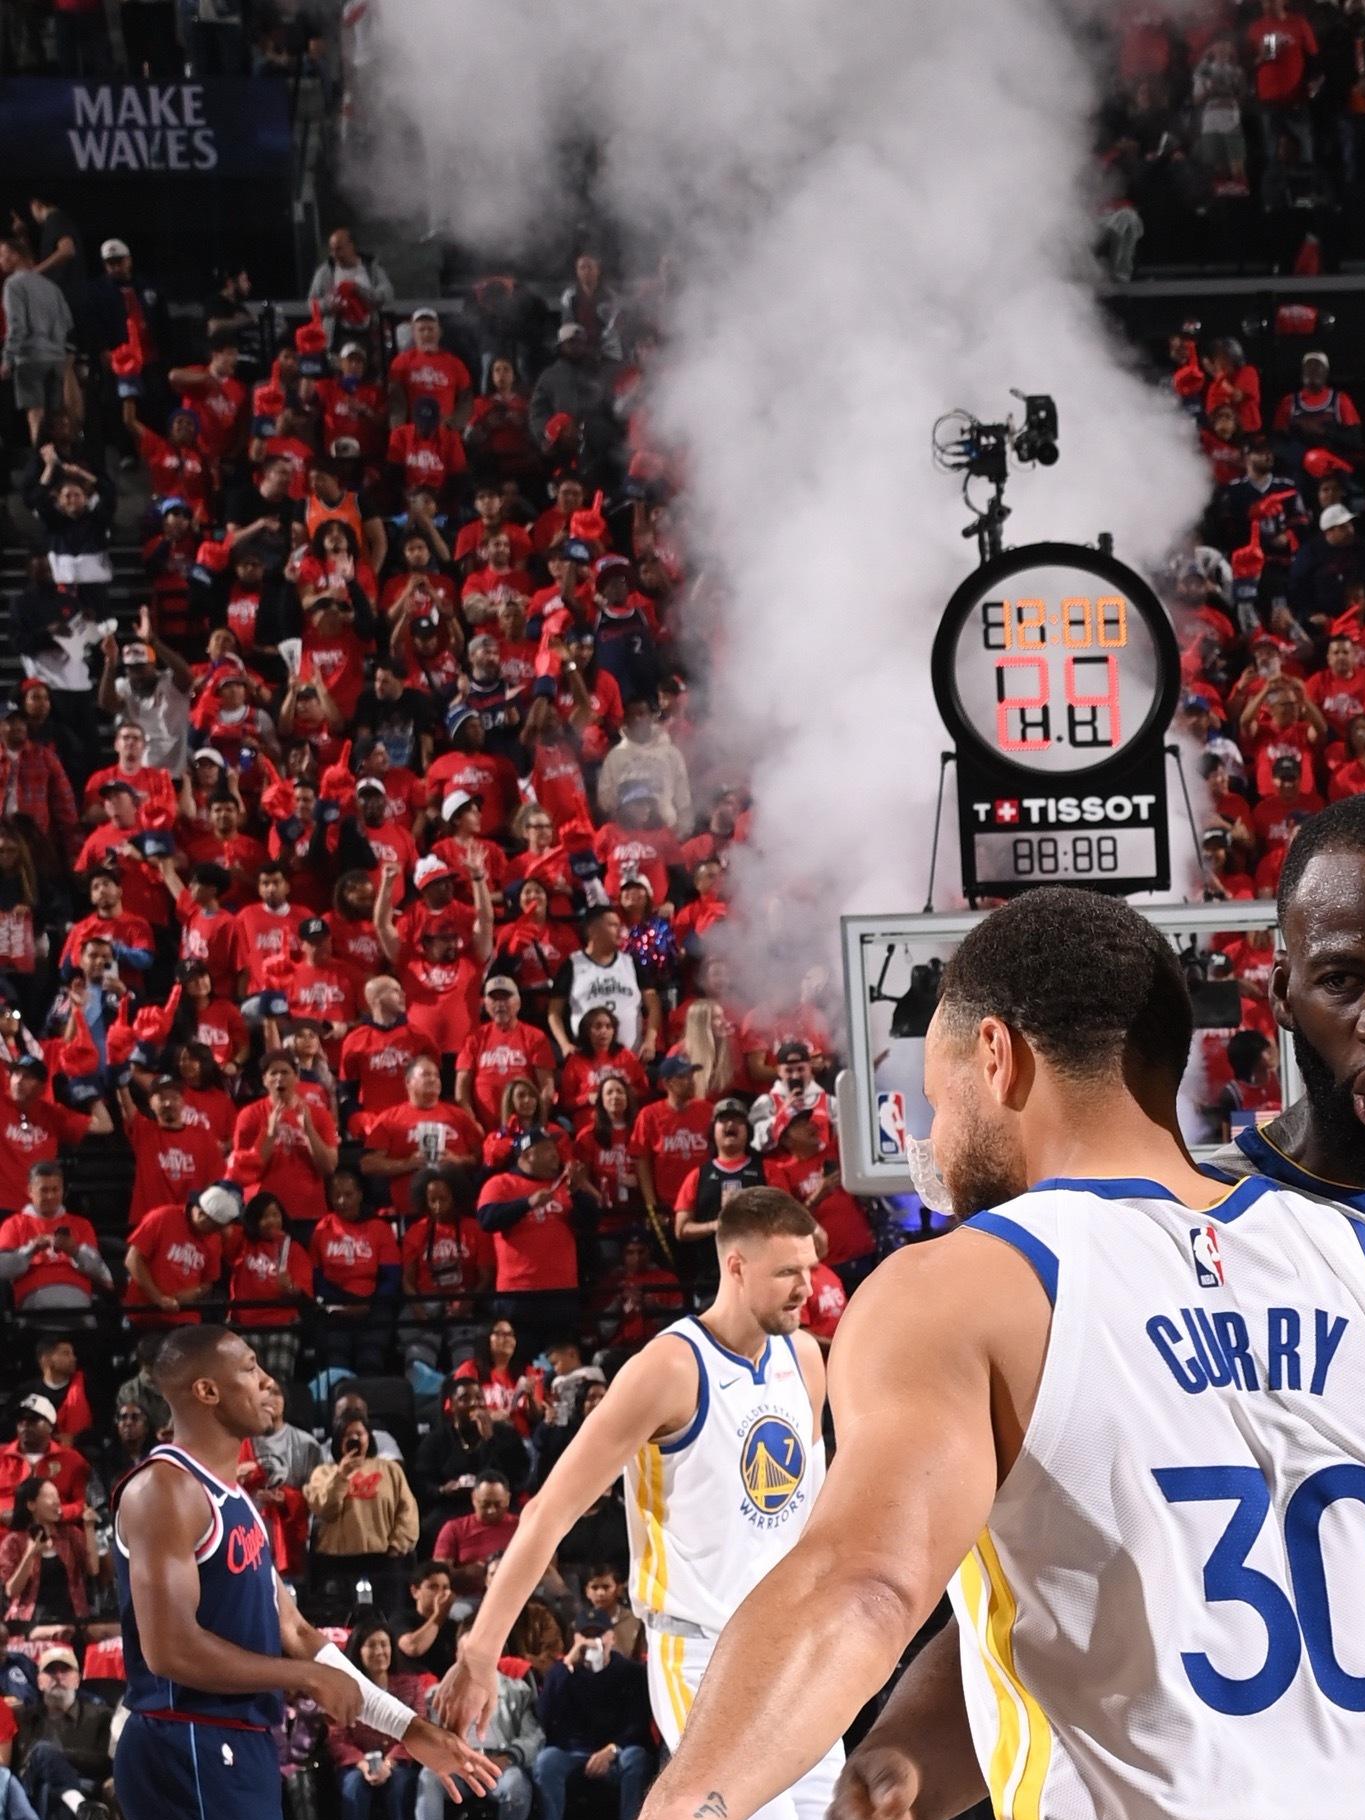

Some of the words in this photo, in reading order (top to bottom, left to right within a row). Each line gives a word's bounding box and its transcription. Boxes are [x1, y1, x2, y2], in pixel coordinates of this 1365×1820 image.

[72, 85, 206, 127] MAKE
[67, 128, 219, 171] WAVES
[1004, 596, 1128, 650] 12:00
[995, 655, 1121, 751] 24
[1022, 795, 1155, 824] TISSOT
[1146, 1308, 1349, 1397] CURRY
[784, 1438, 795, 1466] 7
[740, 1491, 805, 1530] WARRIORS
